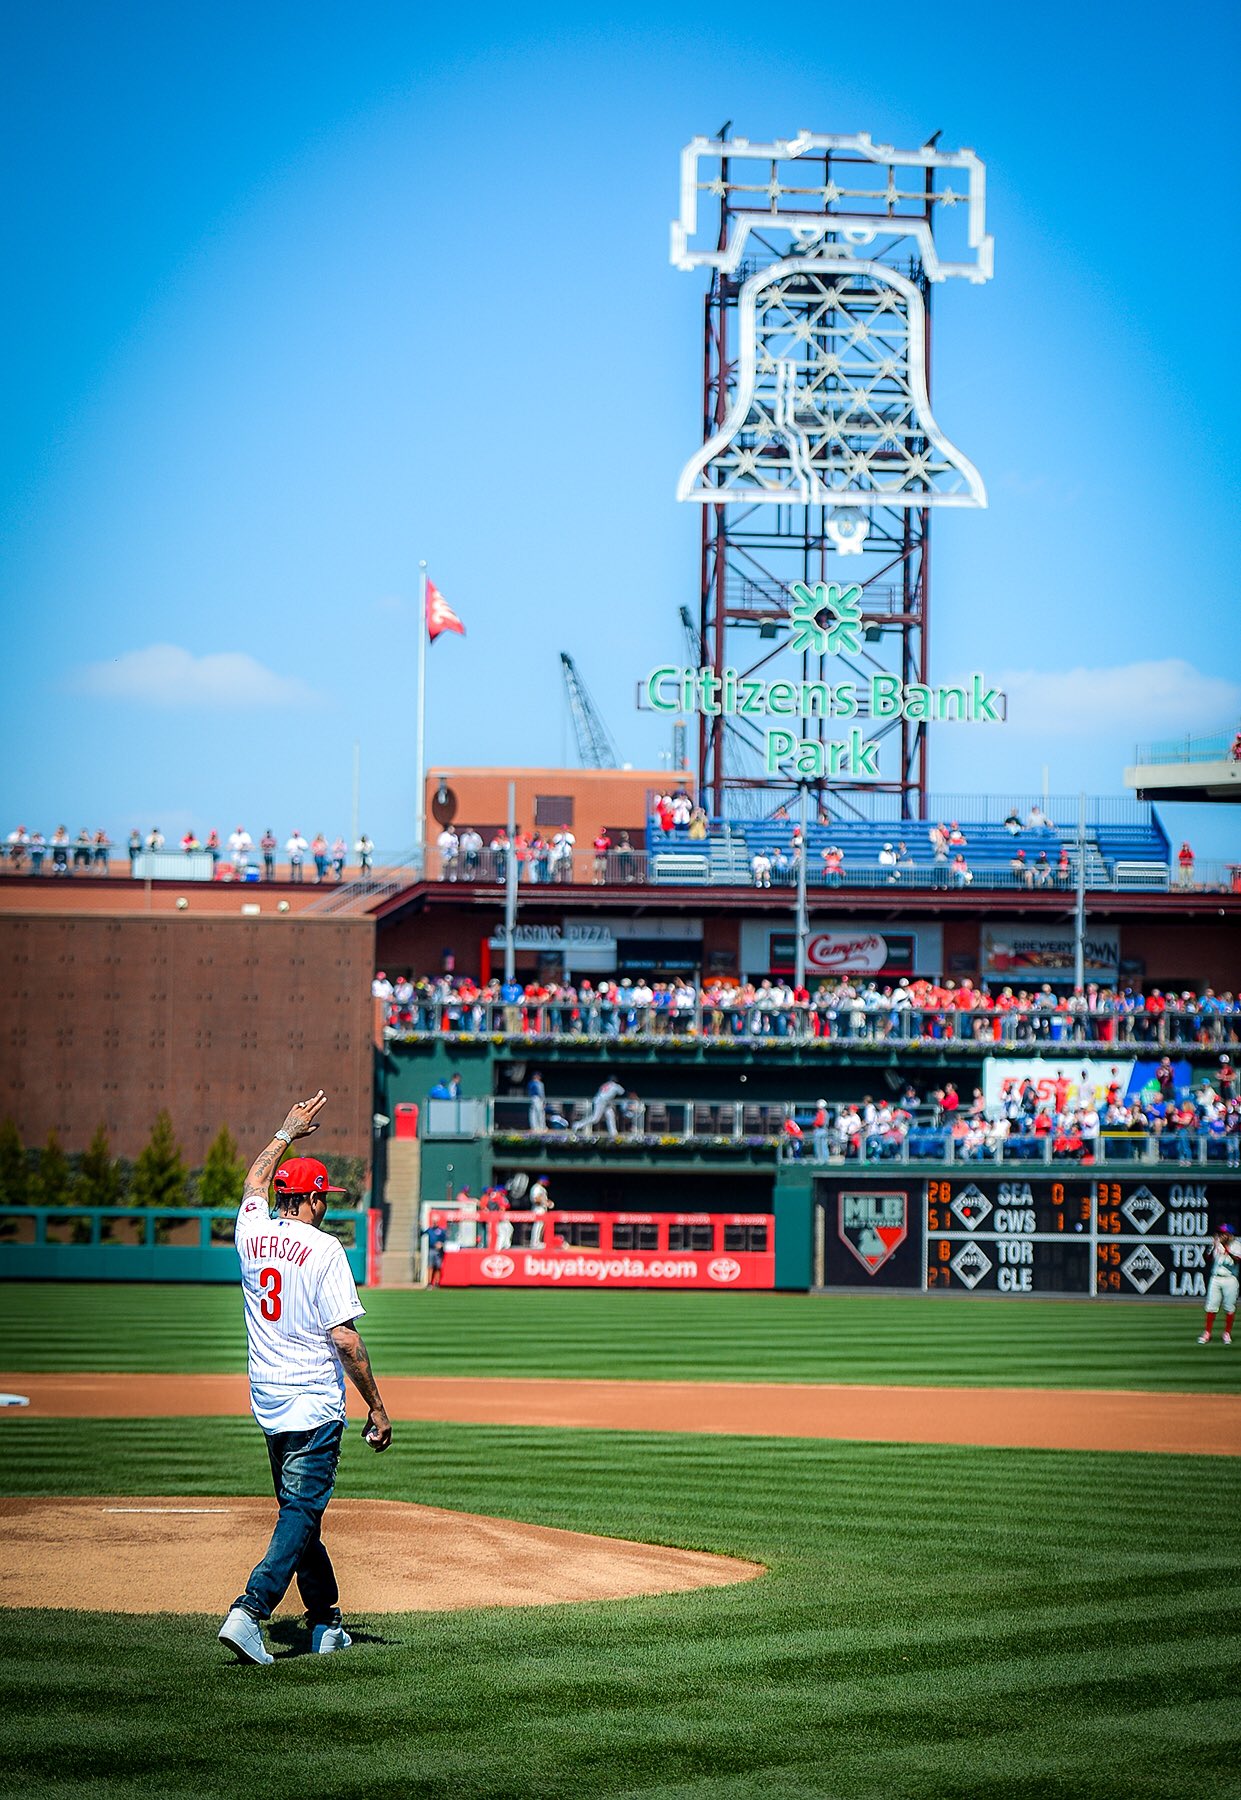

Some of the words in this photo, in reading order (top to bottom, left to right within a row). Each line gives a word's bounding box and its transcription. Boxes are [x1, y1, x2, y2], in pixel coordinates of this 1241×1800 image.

[648, 665, 859, 718] Citizens
[870, 671, 1003, 722] Bank
[766, 726, 881, 778] Park
[494, 923, 561, 942] SASONS
[569, 924, 612, 945] PIZZA
[997, 1182, 1034, 1206] SEA
[1169, 1184, 1210, 1208] OAK
[844, 1197, 904, 1219] MLB
[993, 1208, 1037, 1233] CWS
[1167, 1211, 1209, 1236] HOU
[246, 1236, 312, 1267] IVERSON
[996, 1240, 1034, 1265] TOR
[1169, 1243, 1207, 1268] TEX
[524, 1254, 698, 1281] buyatoyota.com
[997, 1266, 1033, 1292] CLE
[259, 1267, 283, 1323] 3
[1169, 1270, 1207, 1297] LAA
